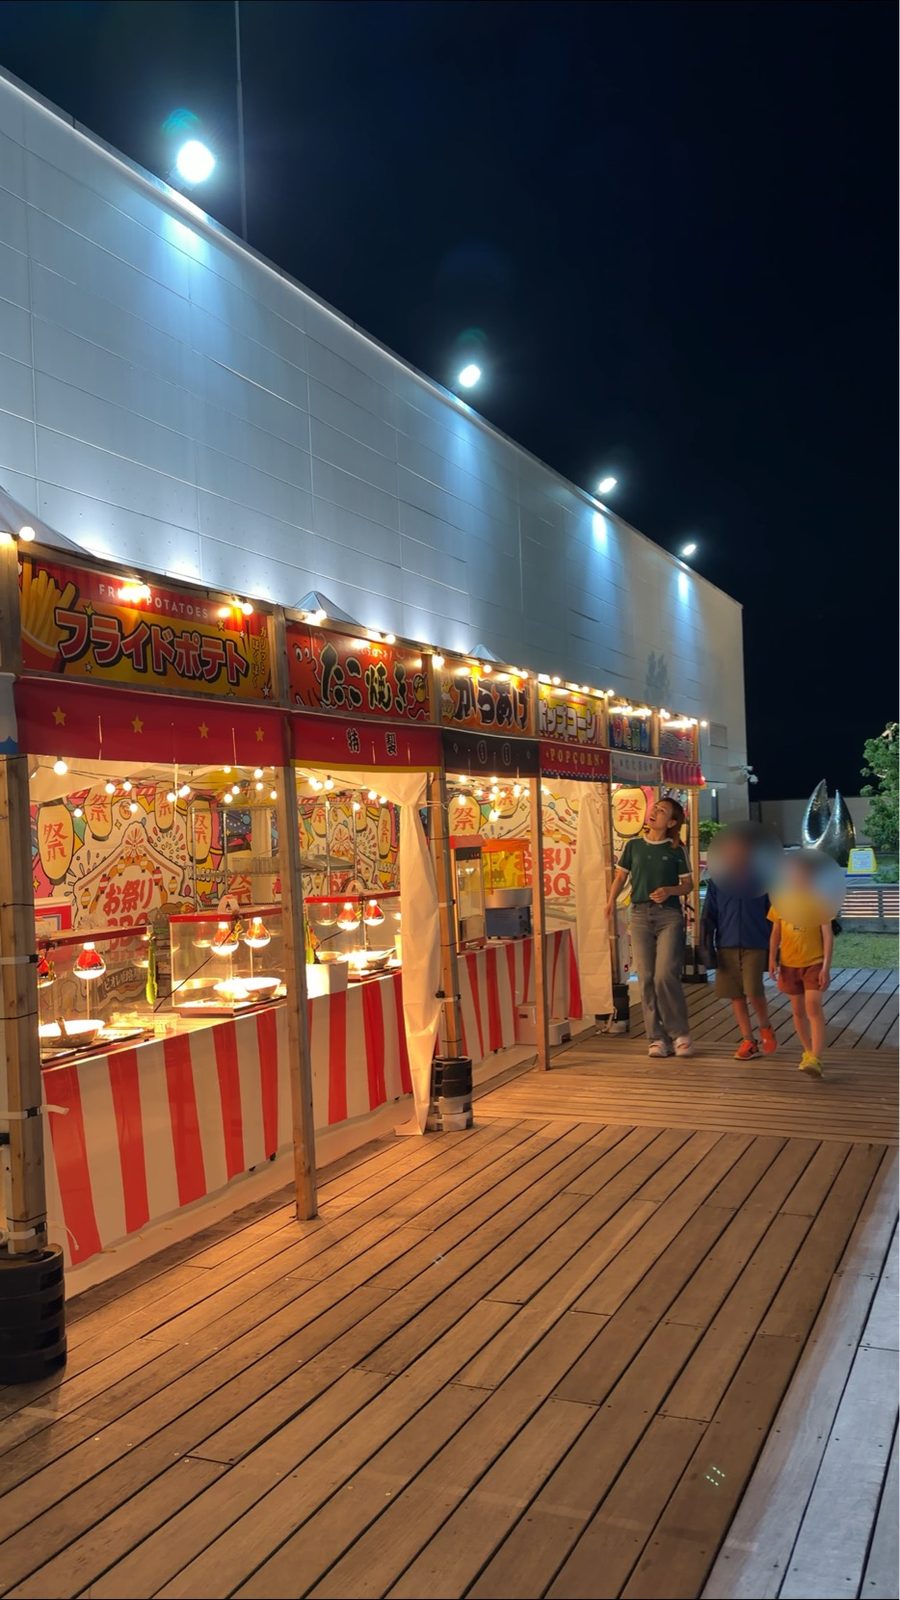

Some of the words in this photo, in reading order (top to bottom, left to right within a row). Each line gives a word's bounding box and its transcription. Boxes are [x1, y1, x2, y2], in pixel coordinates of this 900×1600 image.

[146, 595, 209, 619] POTATOES
[56, 609, 248, 683] フライドポテト
[320, 643, 406, 713] たこ焼き
[454, 677, 529, 730] からあげ
[538, 698, 597, 739] ポップコーン
[347, 728, 397, 756] 特製
[550, 748, 600, 766] POPCORN
[90, 794, 109, 823] 祭
[453, 807, 475, 831] 祭
[617, 799, 642, 823] 祭
[43, 822, 68, 862] 祭
[102, 877, 153, 915] お祭り
